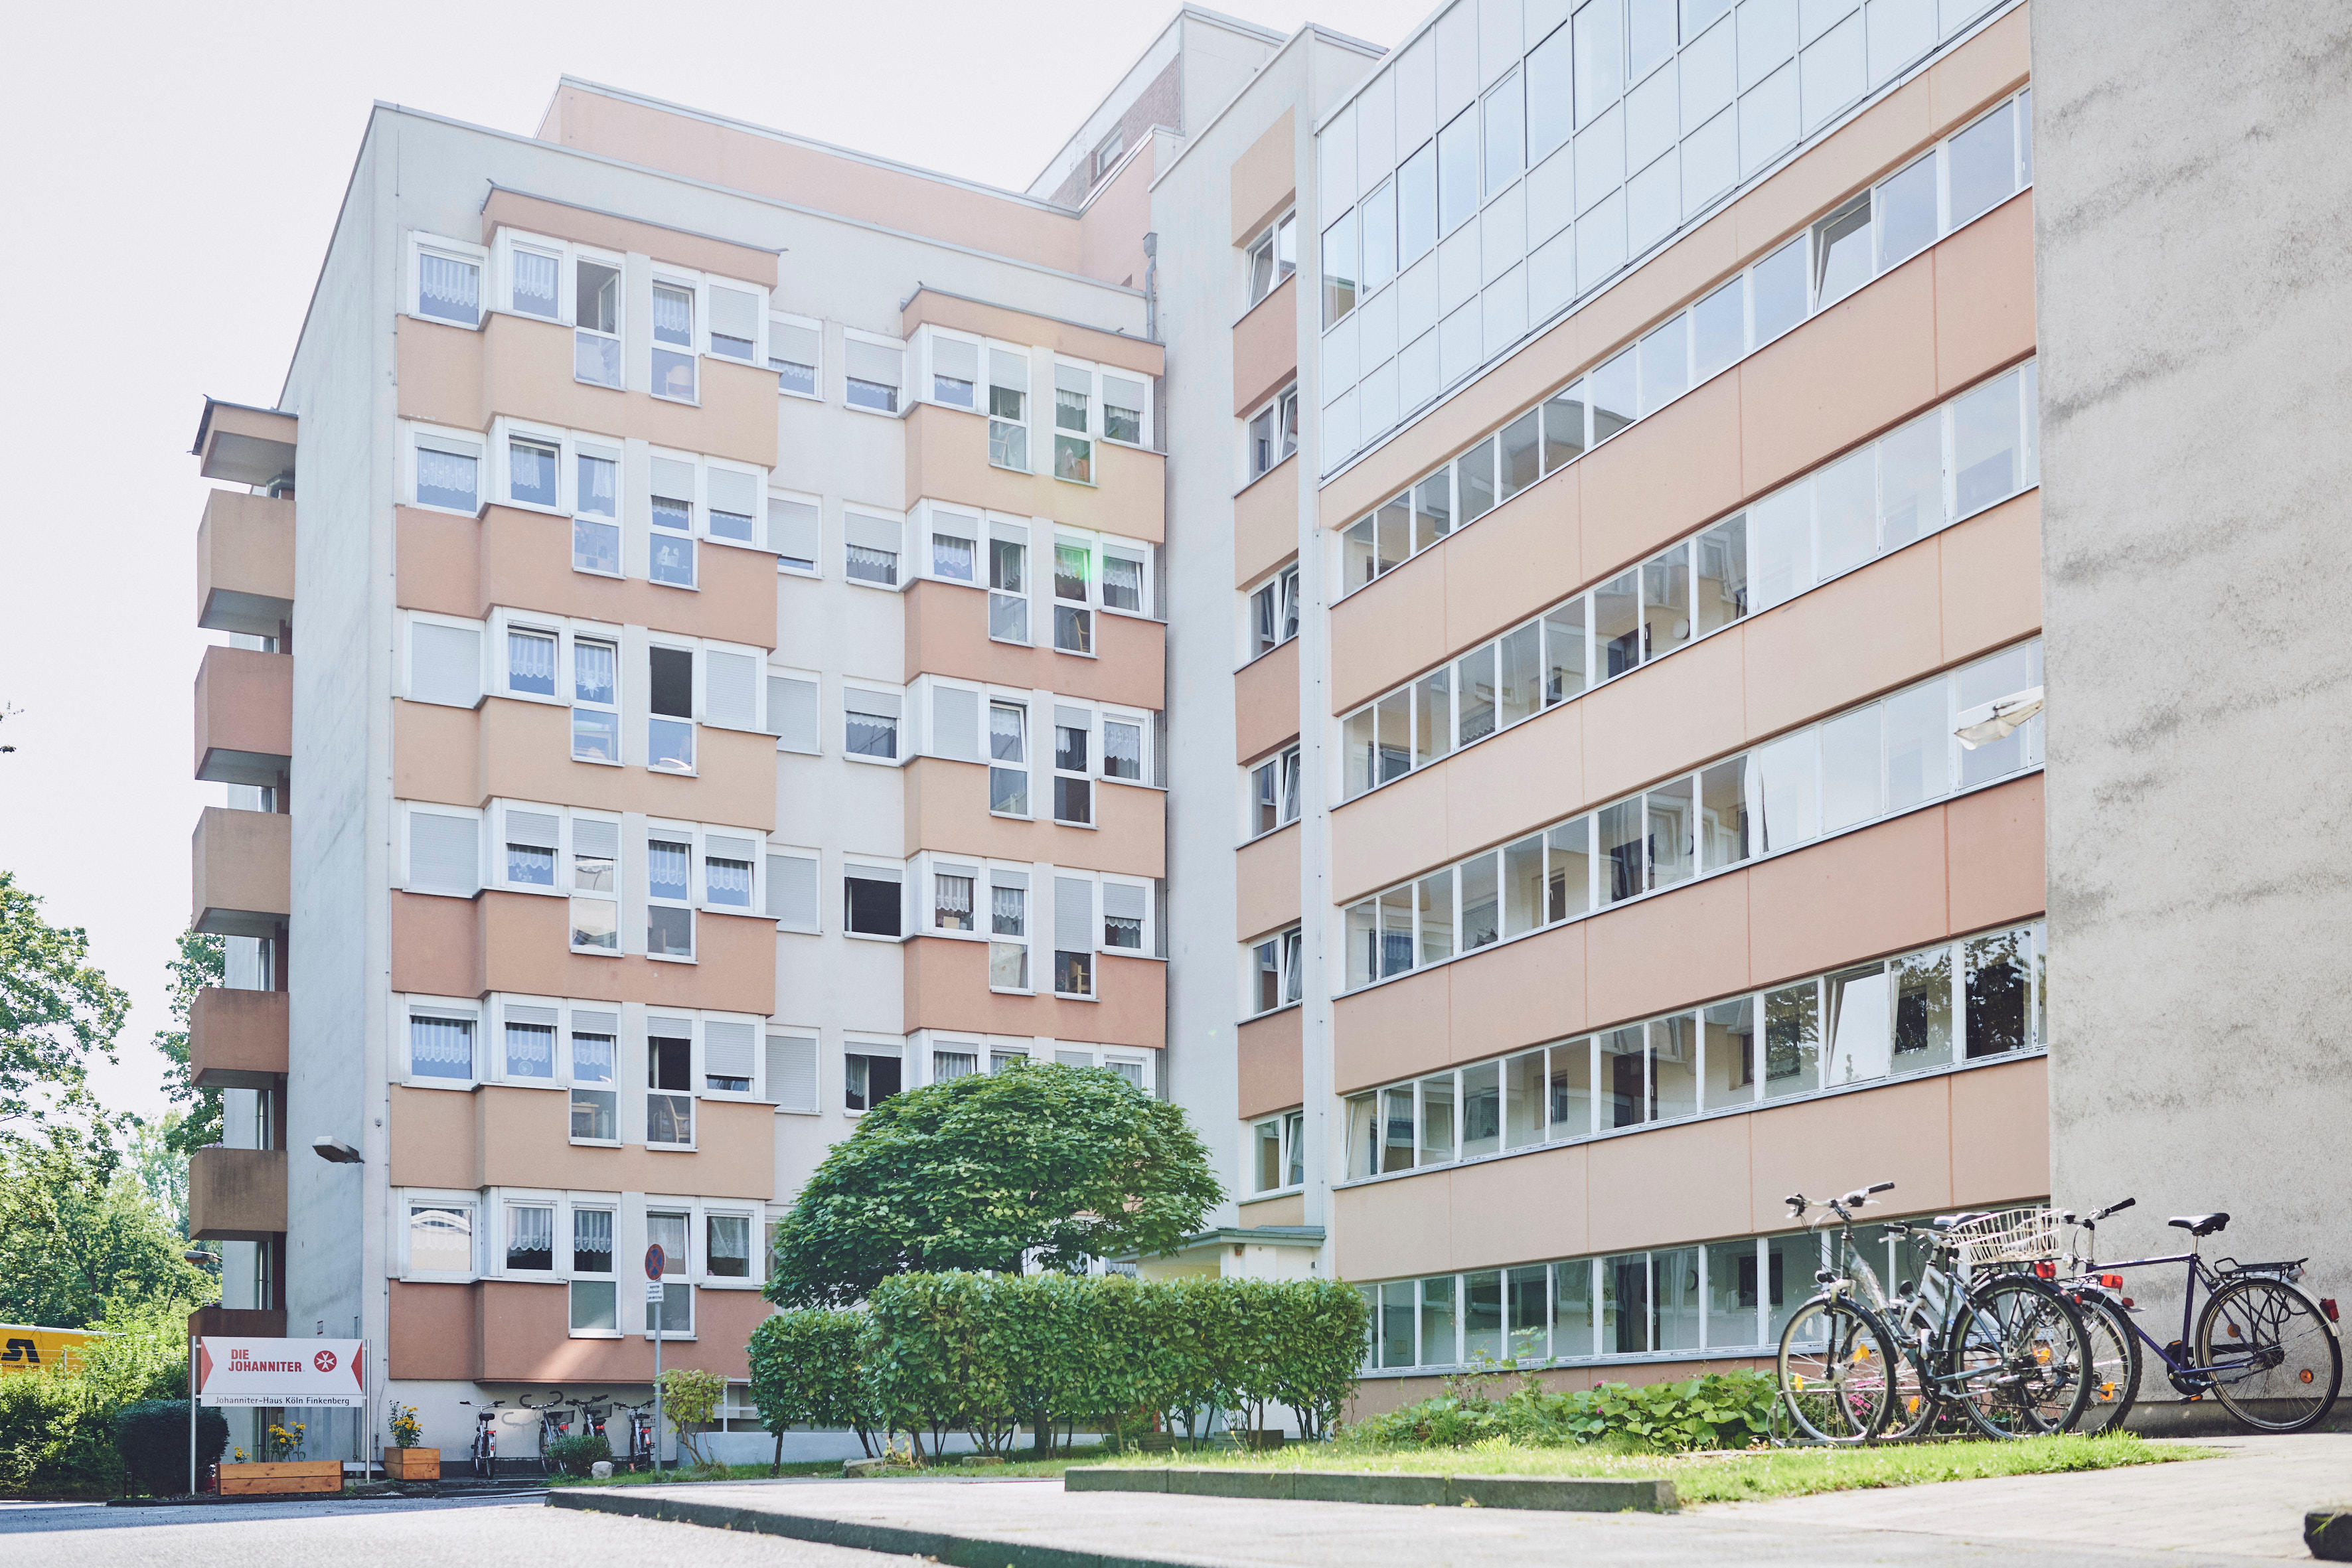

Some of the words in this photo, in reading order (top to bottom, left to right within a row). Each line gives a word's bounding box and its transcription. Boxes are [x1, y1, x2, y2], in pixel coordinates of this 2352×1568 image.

[231, 1349, 249, 1360] DIE
[228, 1361, 302, 1372] JOHANNITER
[306, 1397, 349, 1406] Finkenberg
